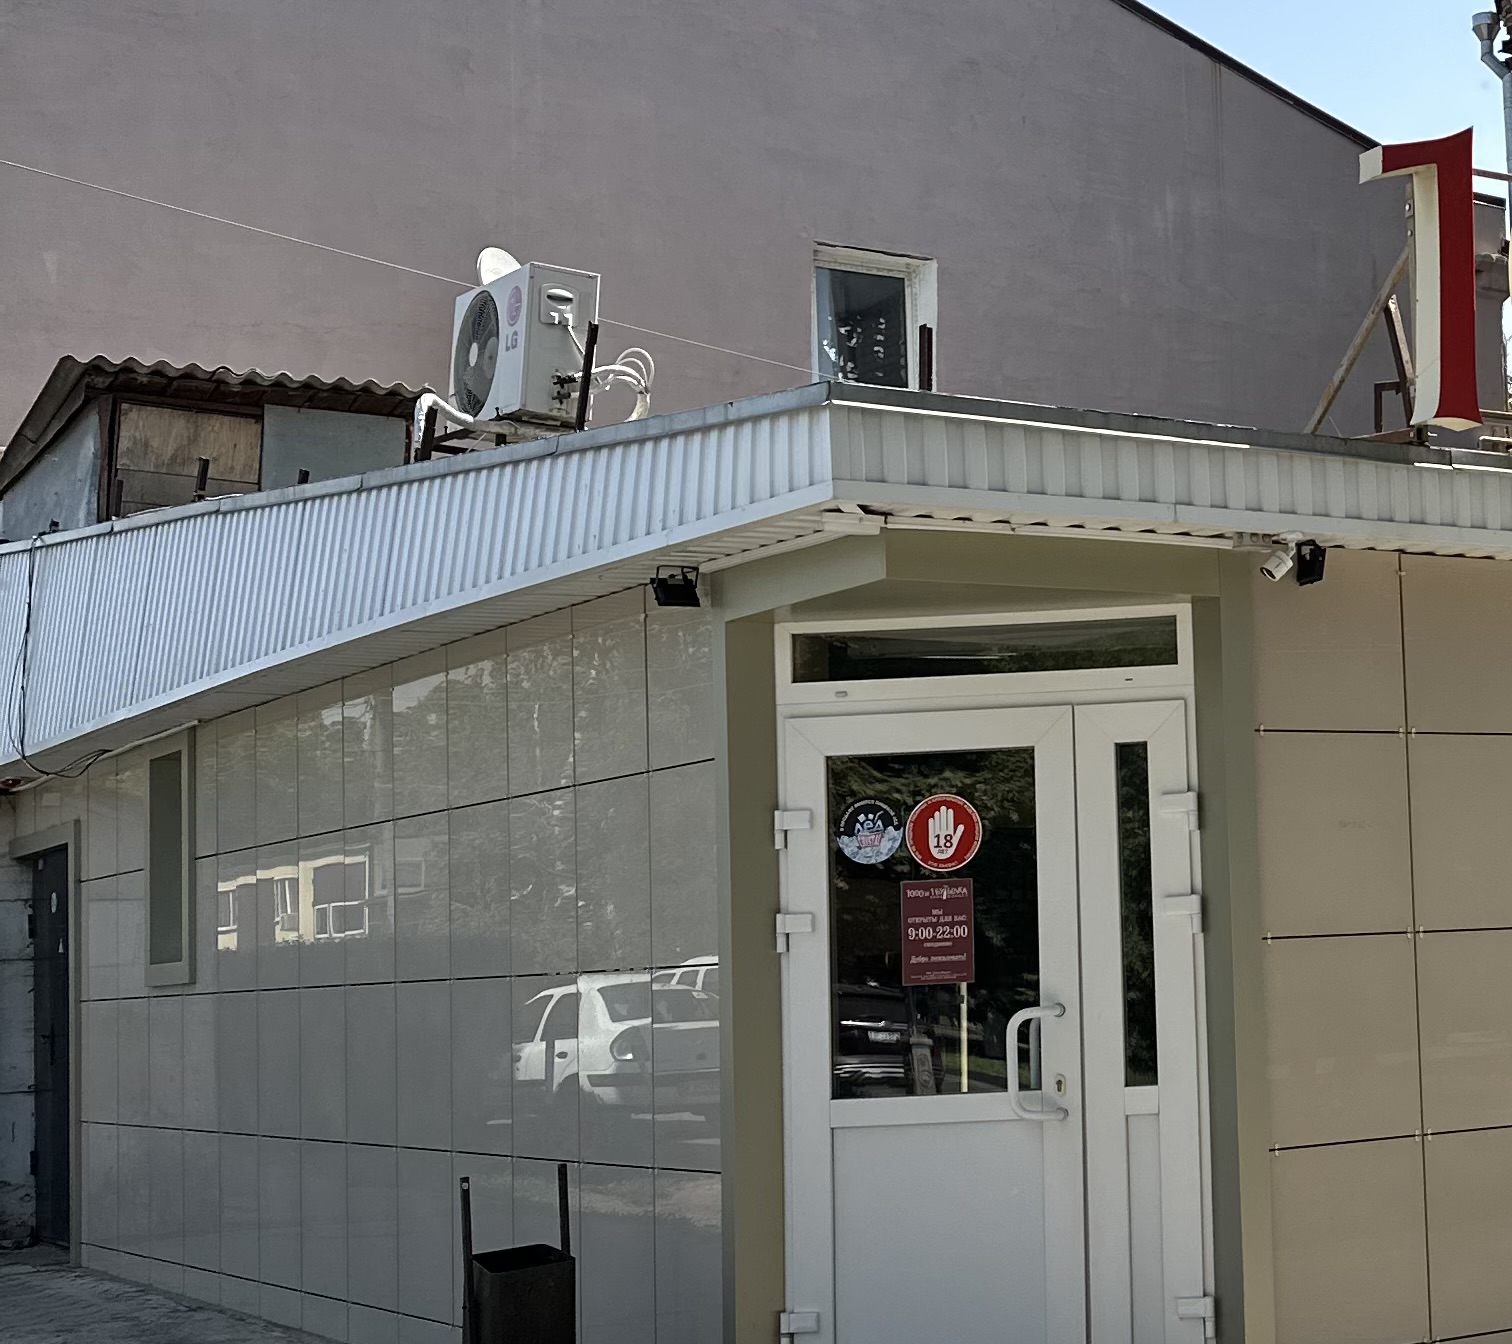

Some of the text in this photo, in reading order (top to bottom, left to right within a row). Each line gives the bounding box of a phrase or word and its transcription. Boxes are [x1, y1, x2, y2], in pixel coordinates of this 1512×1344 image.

[505, 330, 519, 352] LG
[933, 833, 953, 849] 18
[907, 925, 968, 940] 9:00-22:00
